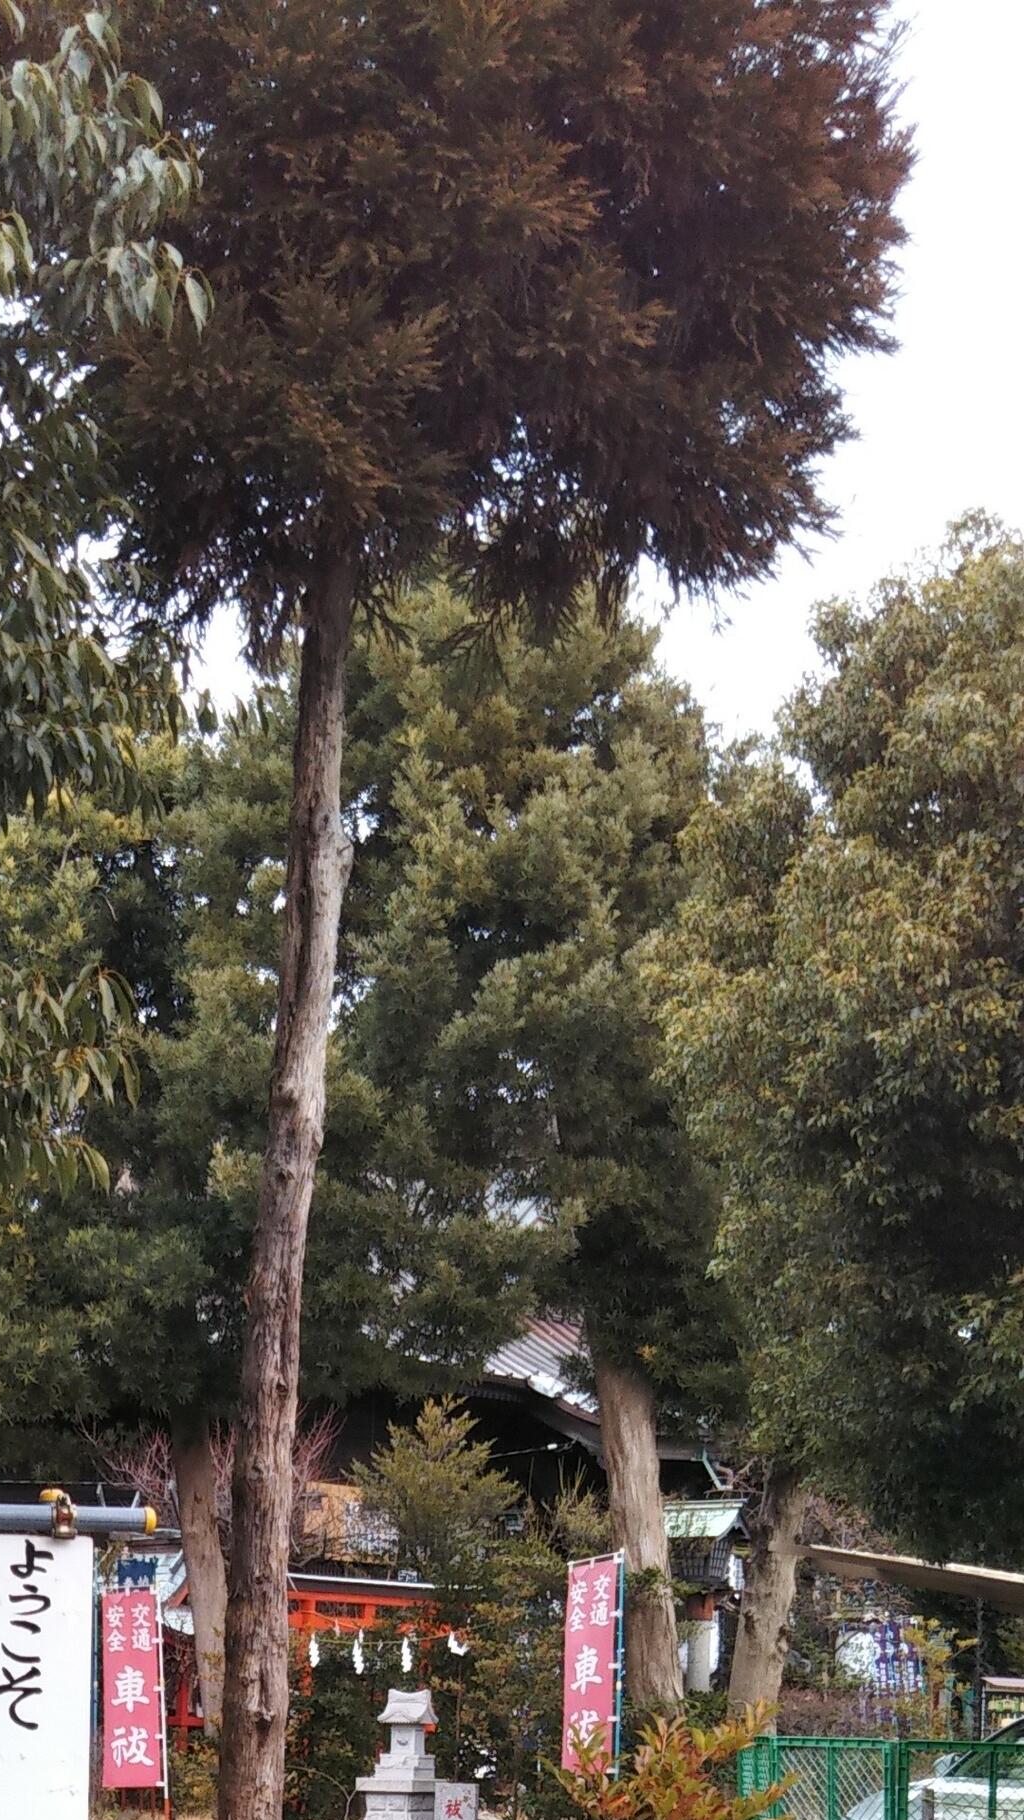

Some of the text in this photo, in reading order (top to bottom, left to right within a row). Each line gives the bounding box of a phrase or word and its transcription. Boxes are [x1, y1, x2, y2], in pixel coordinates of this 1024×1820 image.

[131, 1602, 154, 1652] 交通
[569, 1580, 588, 1633] 安全
[589, 1574, 612, 1628] 交通
[105, 1603, 126, 1653] 安全
[111, 1663, 154, 1768] 車祓
